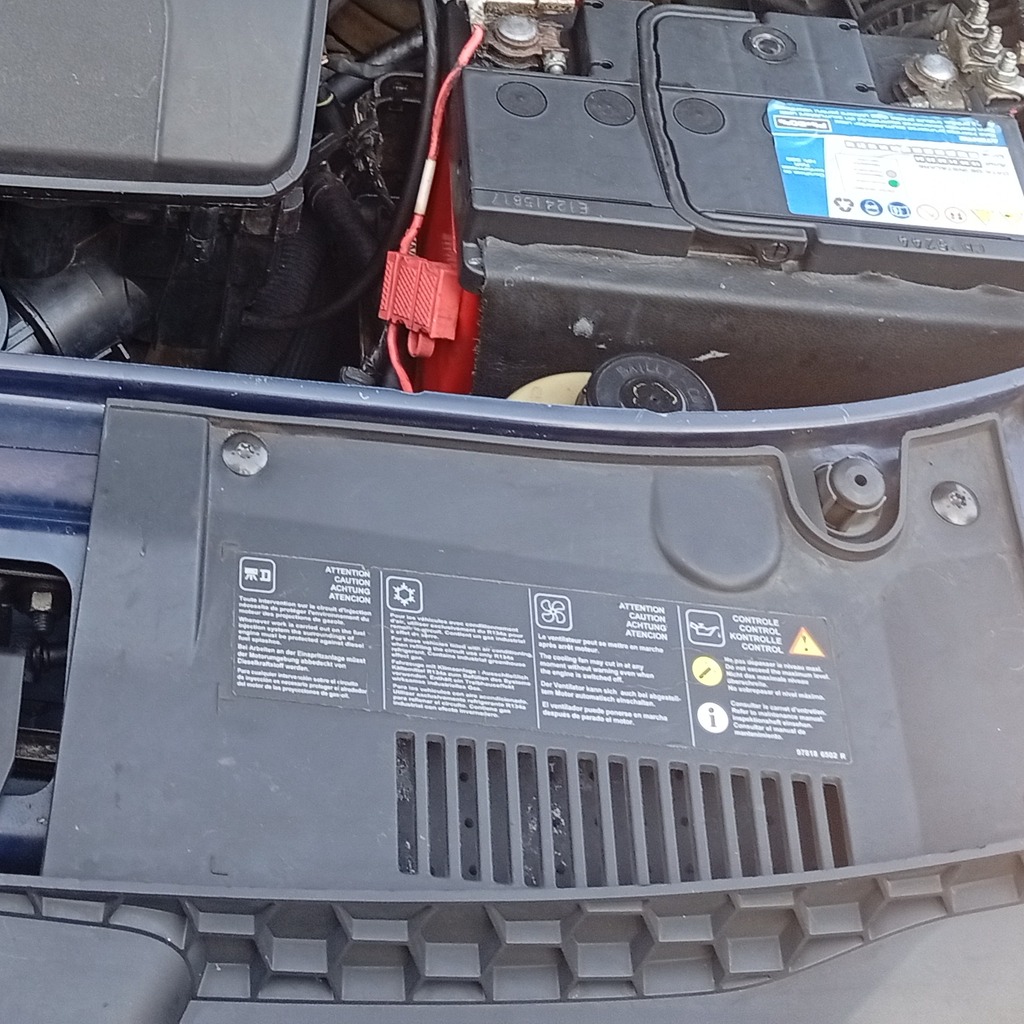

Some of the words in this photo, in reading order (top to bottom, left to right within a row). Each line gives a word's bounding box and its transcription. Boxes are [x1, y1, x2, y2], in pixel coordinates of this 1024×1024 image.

[325, 566, 370, 577] ATTENTION
[334, 576, 370, 586] CAUTION
[330, 584, 370, 594] ACHTUNG
[329, 592, 370, 603] ATENCION
[618, 602, 665, 613] ATTENTION
[629, 612, 665, 622] CAUTION
[731, 614, 779, 626] CONTROLE
[625, 620, 666, 631] ACHTUNG
[738, 624, 781, 635] CONTROL
[625, 629, 667, 640] ATENCION
[729, 632, 782, 645] KONTROLLE
[741, 642, 784, 654] CONTROL
[552, 654, 576, 662] cooling
[839, 752, 847, 760] R
